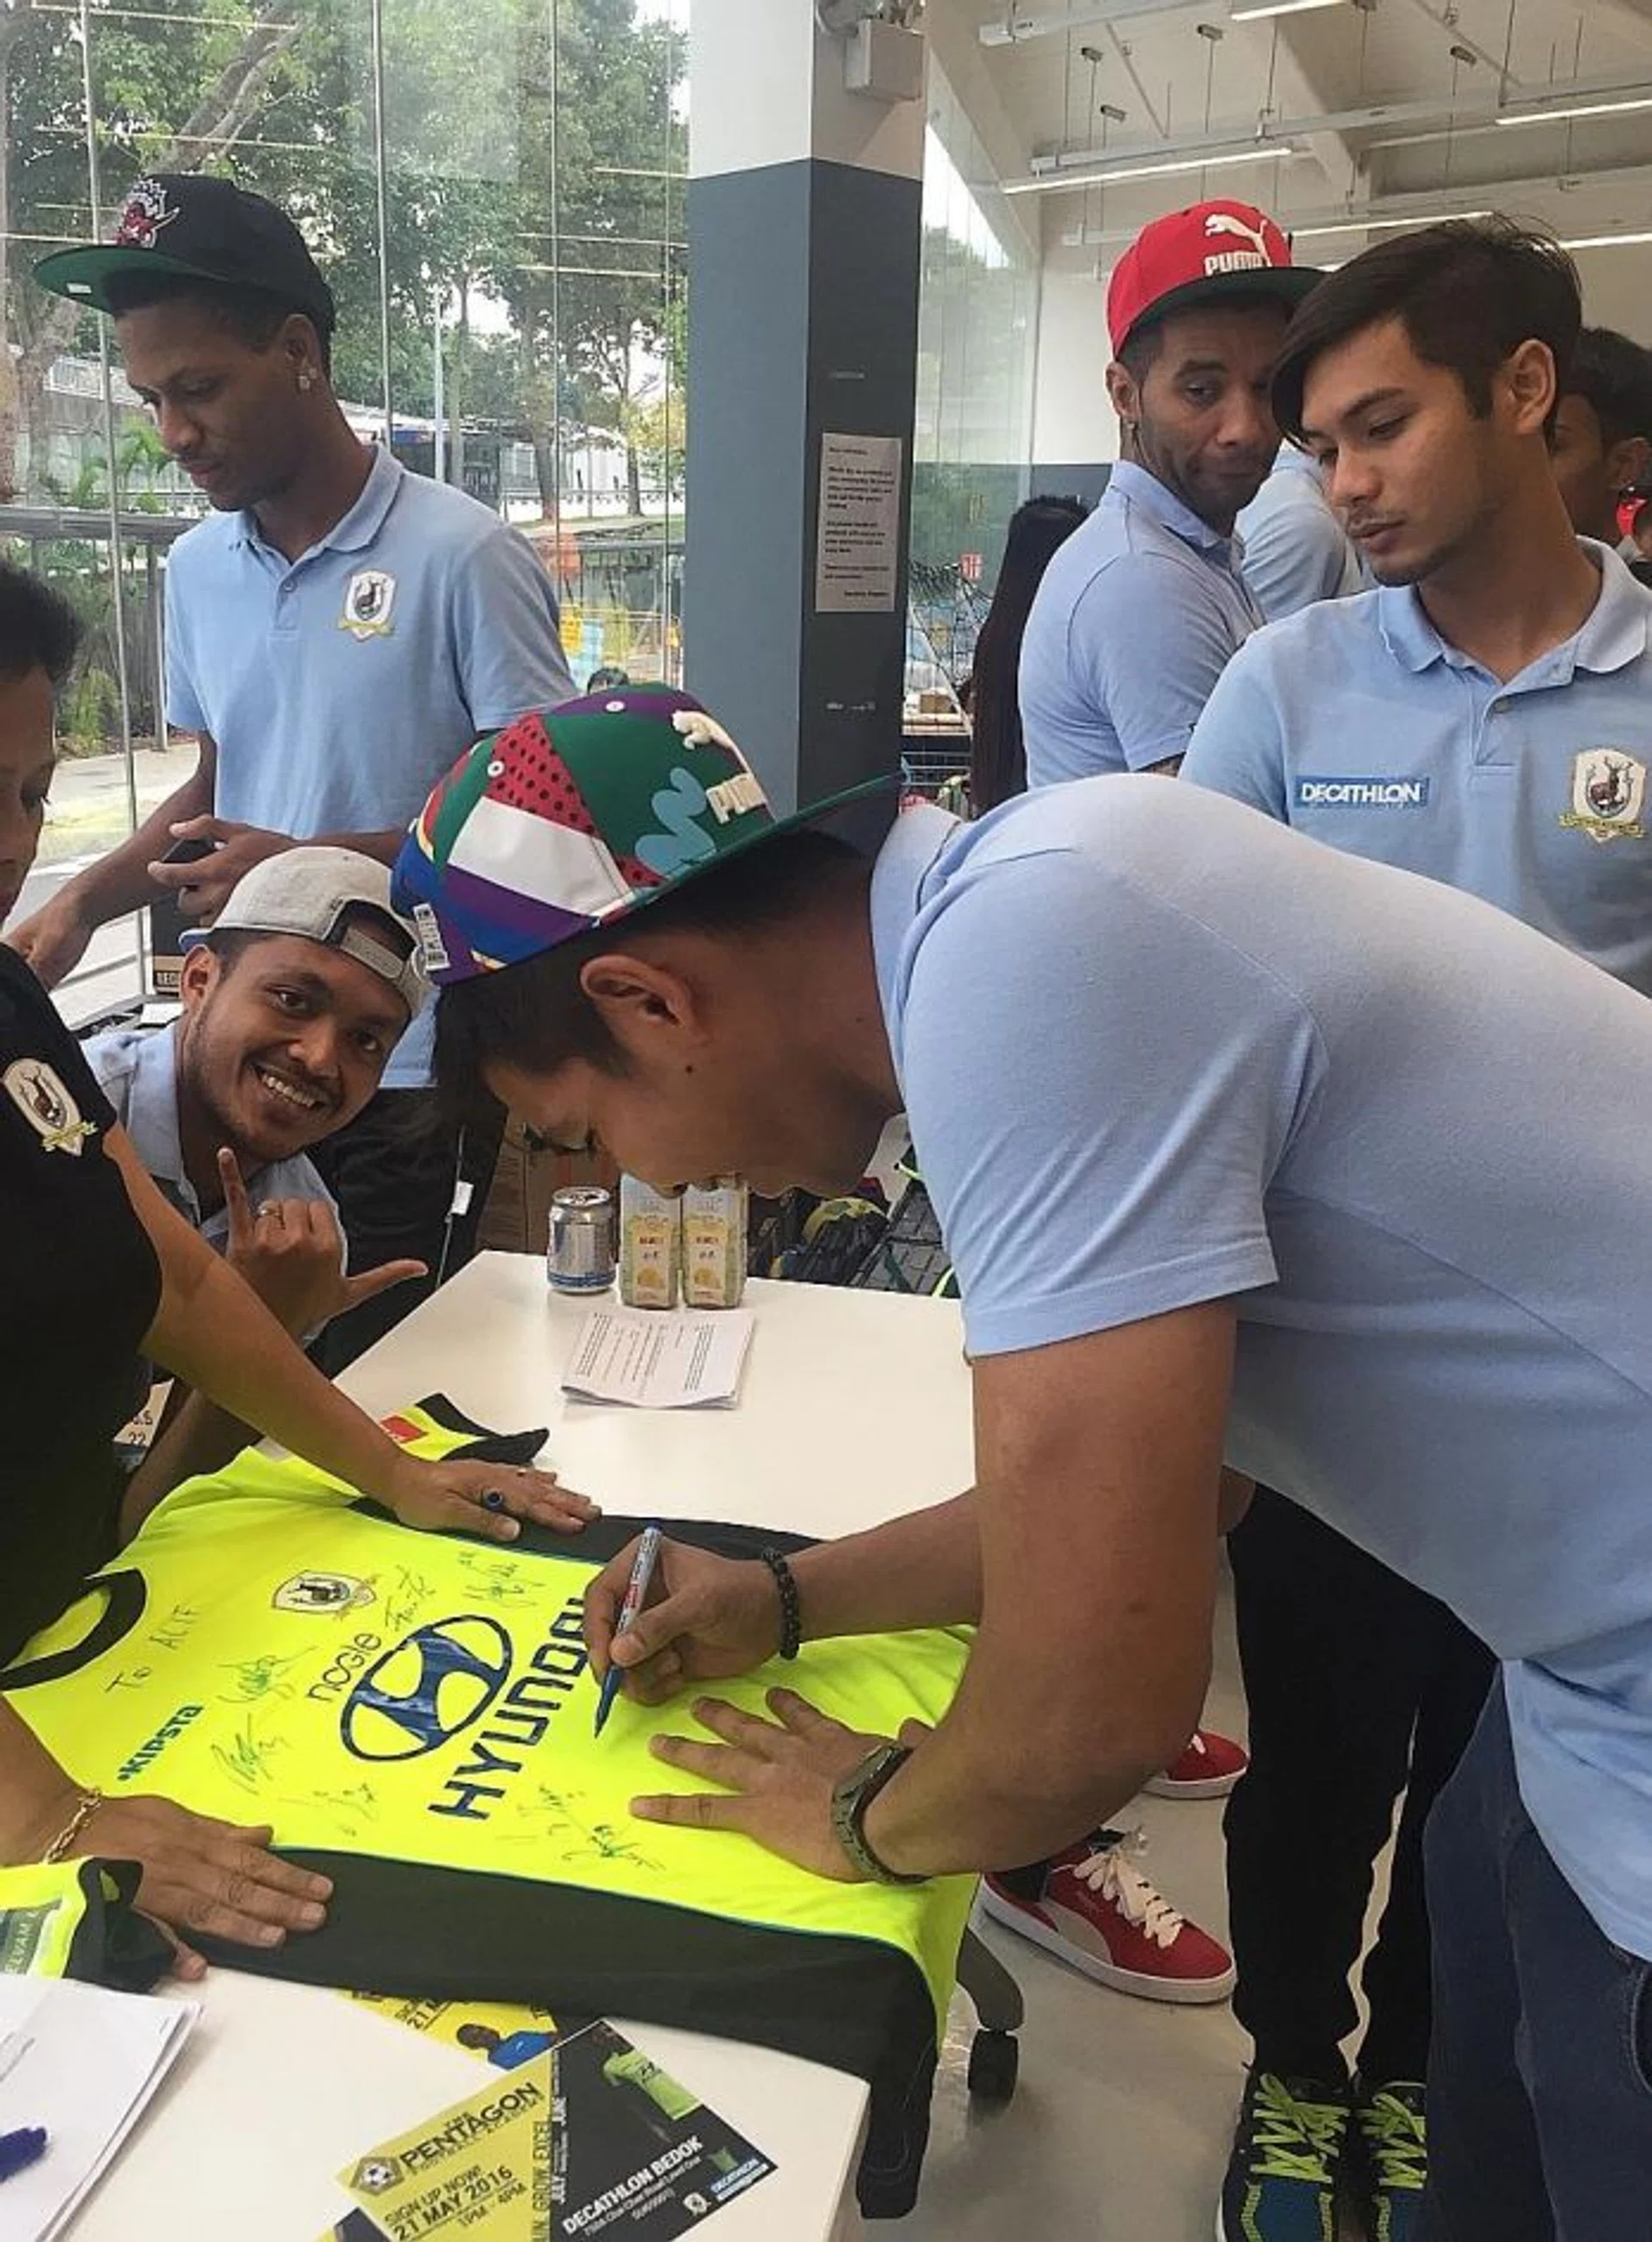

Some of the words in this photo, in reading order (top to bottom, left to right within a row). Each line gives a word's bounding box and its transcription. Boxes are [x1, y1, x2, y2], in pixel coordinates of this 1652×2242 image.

[1205, 250, 1265, 276] PUMA
[1300, 782, 1421, 803] DECATHLON
[399, 2081, 541, 2170] PENTAGON
[385, 2201, 422, 2227] SIGN
[421, 2187, 442, 2207] UP
[393, 2218, 420, 2241] 21
[422, 2193, 462, 2226] MAY
[465, 2165, 513, 2201] 2016
[562, 2168, 656, 2235] DECATHLON
[650, 2134, 704, 2177] BEDOK
